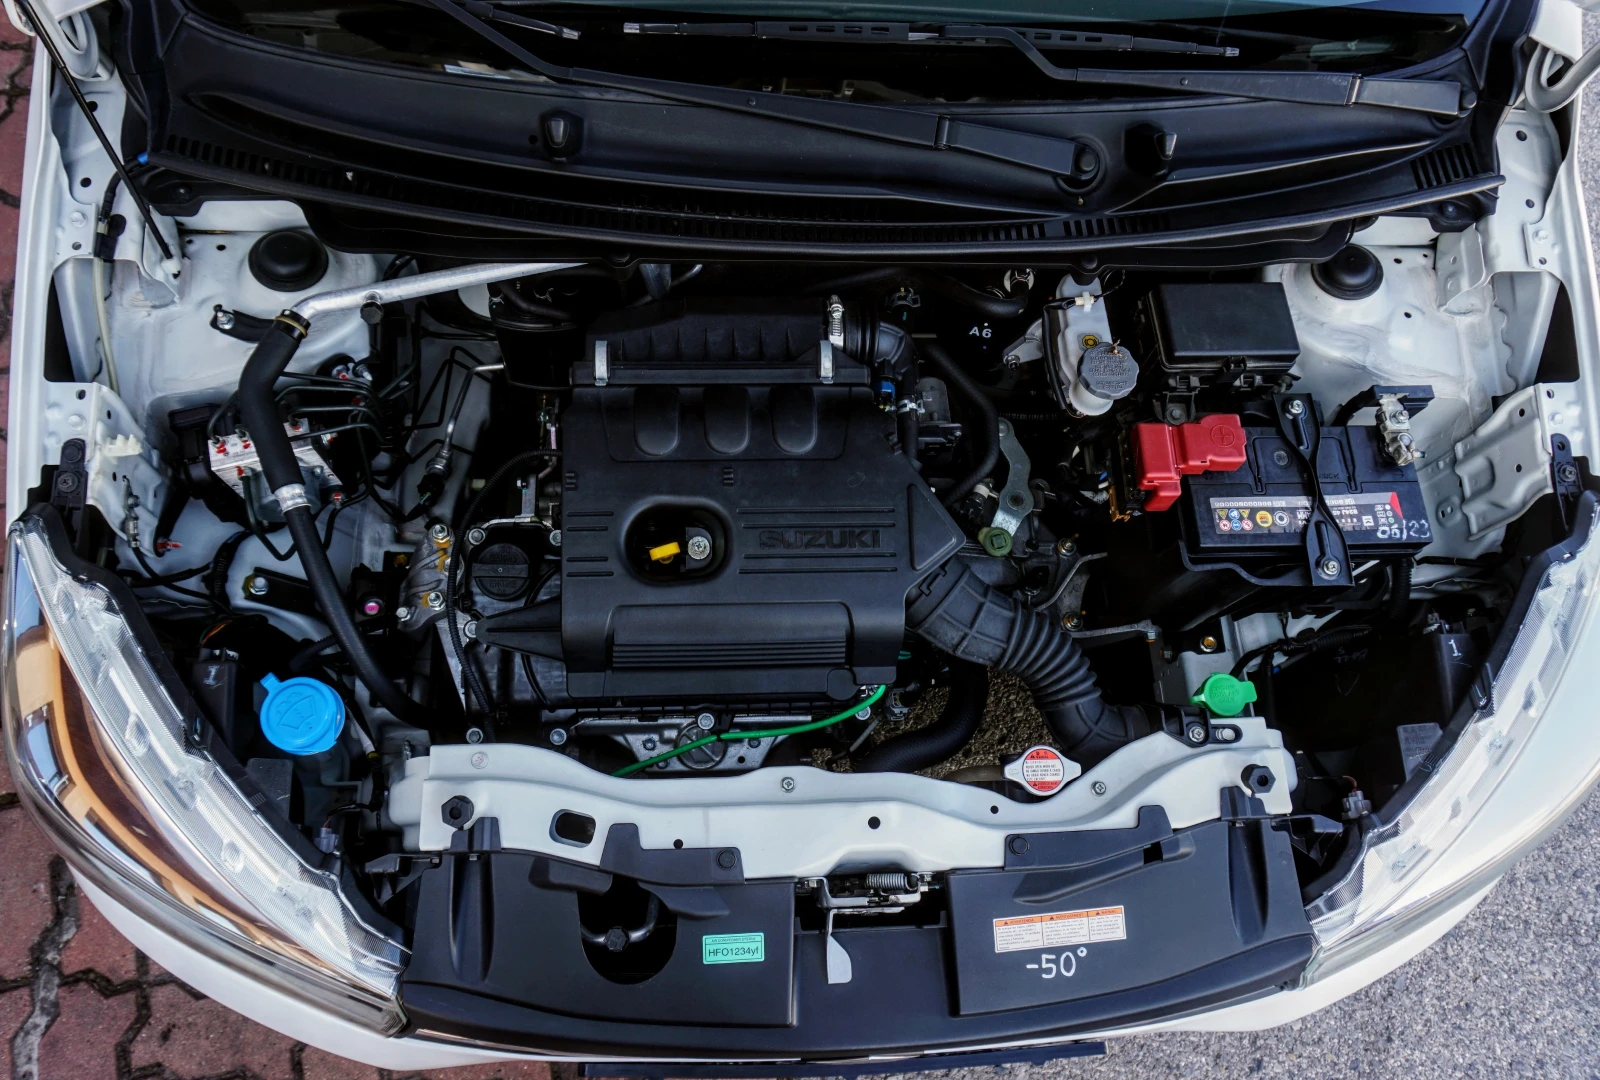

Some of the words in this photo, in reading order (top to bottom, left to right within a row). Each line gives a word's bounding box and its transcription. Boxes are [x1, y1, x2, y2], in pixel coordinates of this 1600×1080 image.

[968, 326, 992, 338] A6
[759, 529, 881, 550] SUZUKI
[708, 946, 759, 957] HFO1234yf
